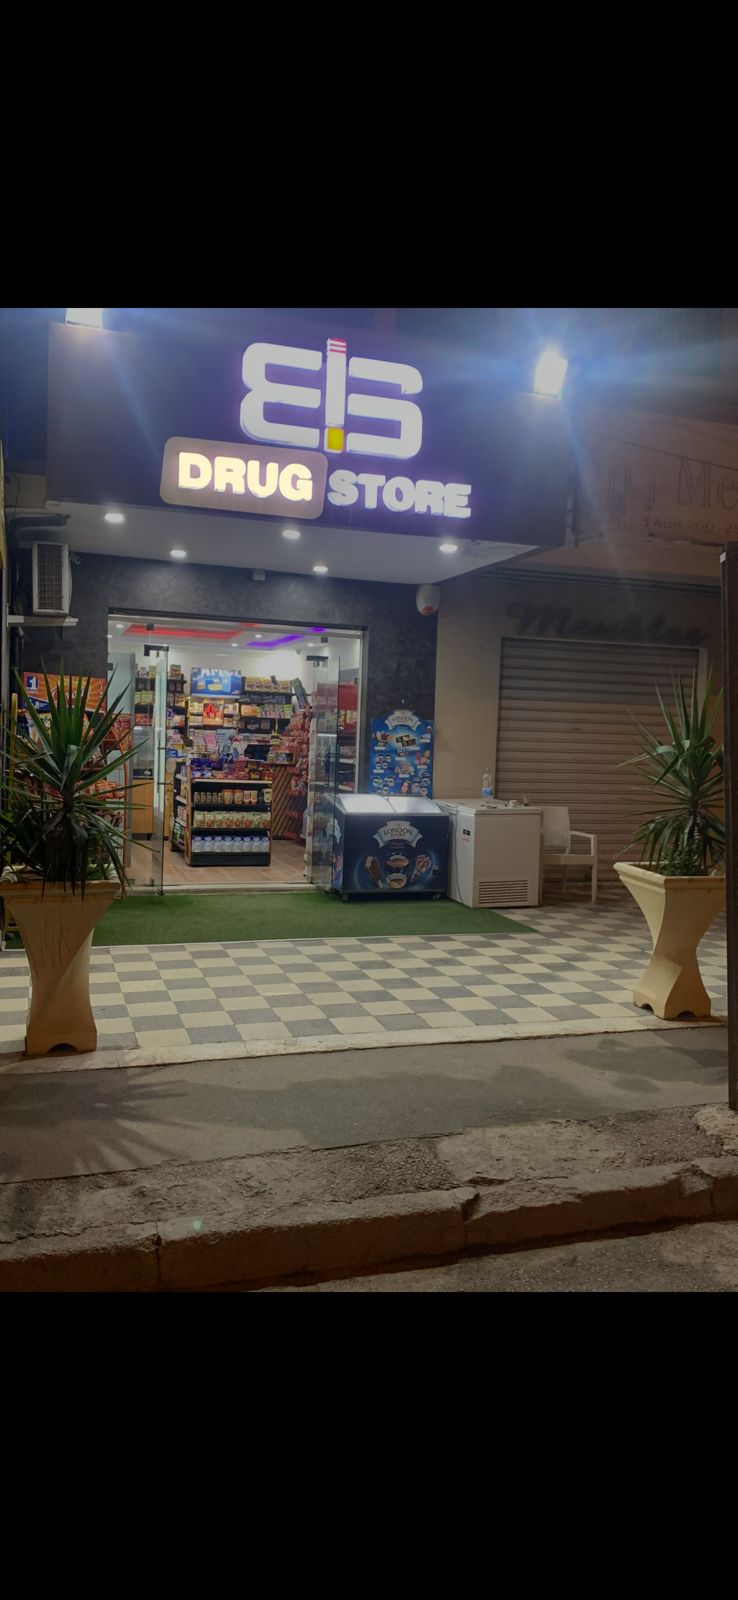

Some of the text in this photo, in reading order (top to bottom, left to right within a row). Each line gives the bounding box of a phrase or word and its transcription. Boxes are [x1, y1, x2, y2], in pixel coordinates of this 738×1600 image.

[178, 451, 472, 518] DRUG STORE
[383, 827, 413, 836] LONDON
